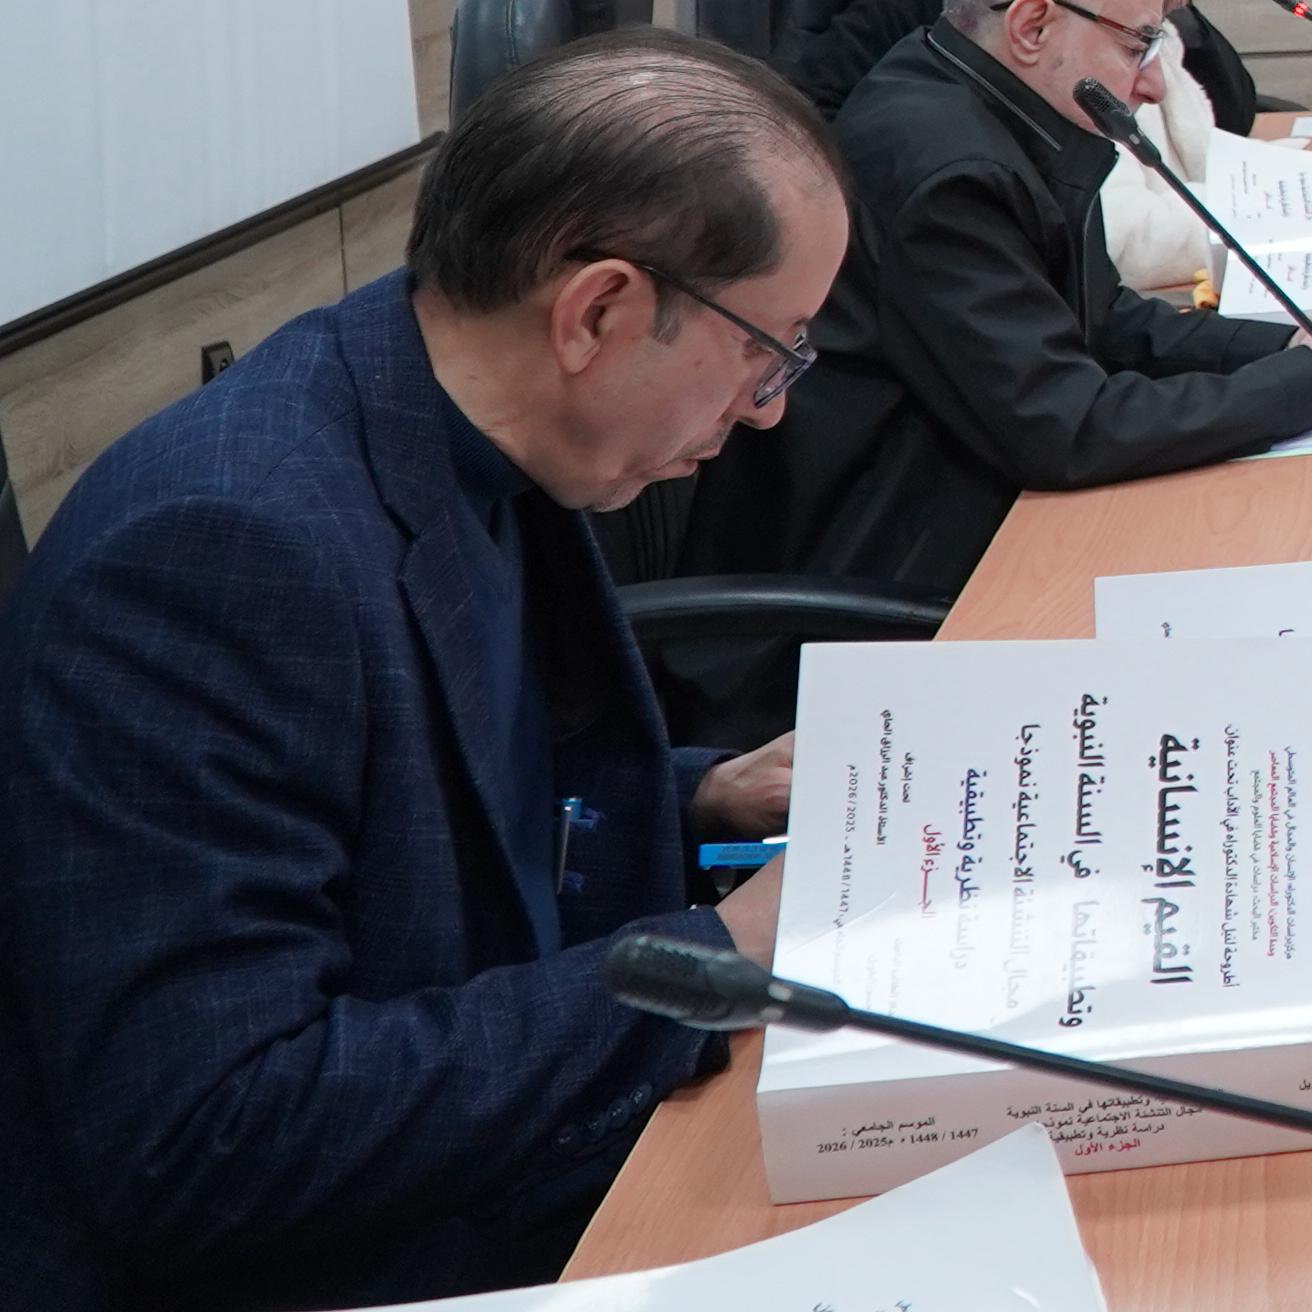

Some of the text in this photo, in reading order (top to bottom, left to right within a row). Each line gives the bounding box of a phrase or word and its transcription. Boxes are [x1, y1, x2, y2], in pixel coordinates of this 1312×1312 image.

[1014, 724, 1041, 788] نموذجا
[878, 765, 888, 781] عبد
[1227, 759, 1239, 785] تحت
[957, 768, 987, 851] وتطبيقية
[1220, 818, 1239, 832] في
[922, 824, 945, 856] الأول
[1010, 791, 1038, 883] الاجتماعية
[1057, 693, 1108, 1028] وتطبيقاتها في السنة النبوية
[1141, 733, 1200, 985] القيم الإنسانية
[1222, 834, 1239, 880] الدكتوراه
[954, 855, 984, 909] نظرية
[1224, 882, 1238, 920] شهادة
[1221, 922, 1238, 945] لنيل
[1220, 947, 1241, 987] أطروحة
[1006, 1105, 1042, 1119] النبوية
[1046, 1102, 1074, 1114] السنة
[1078, 1100, 1093, 1114] في
[1135, 1107, 1172, 1120] التنشئة
[898, 1116, 936, 1133] الموسم
[1077, 1111, 1131, 1126] الاجتماعية
[1133, 1122, 1165, 1134] دراسة
[852, 1121, 894, 1137] الجامعي
[1097, 1126, 1129, 1139] نظرية
[1074, 1139, 1141, 1157] الجزء الأول
